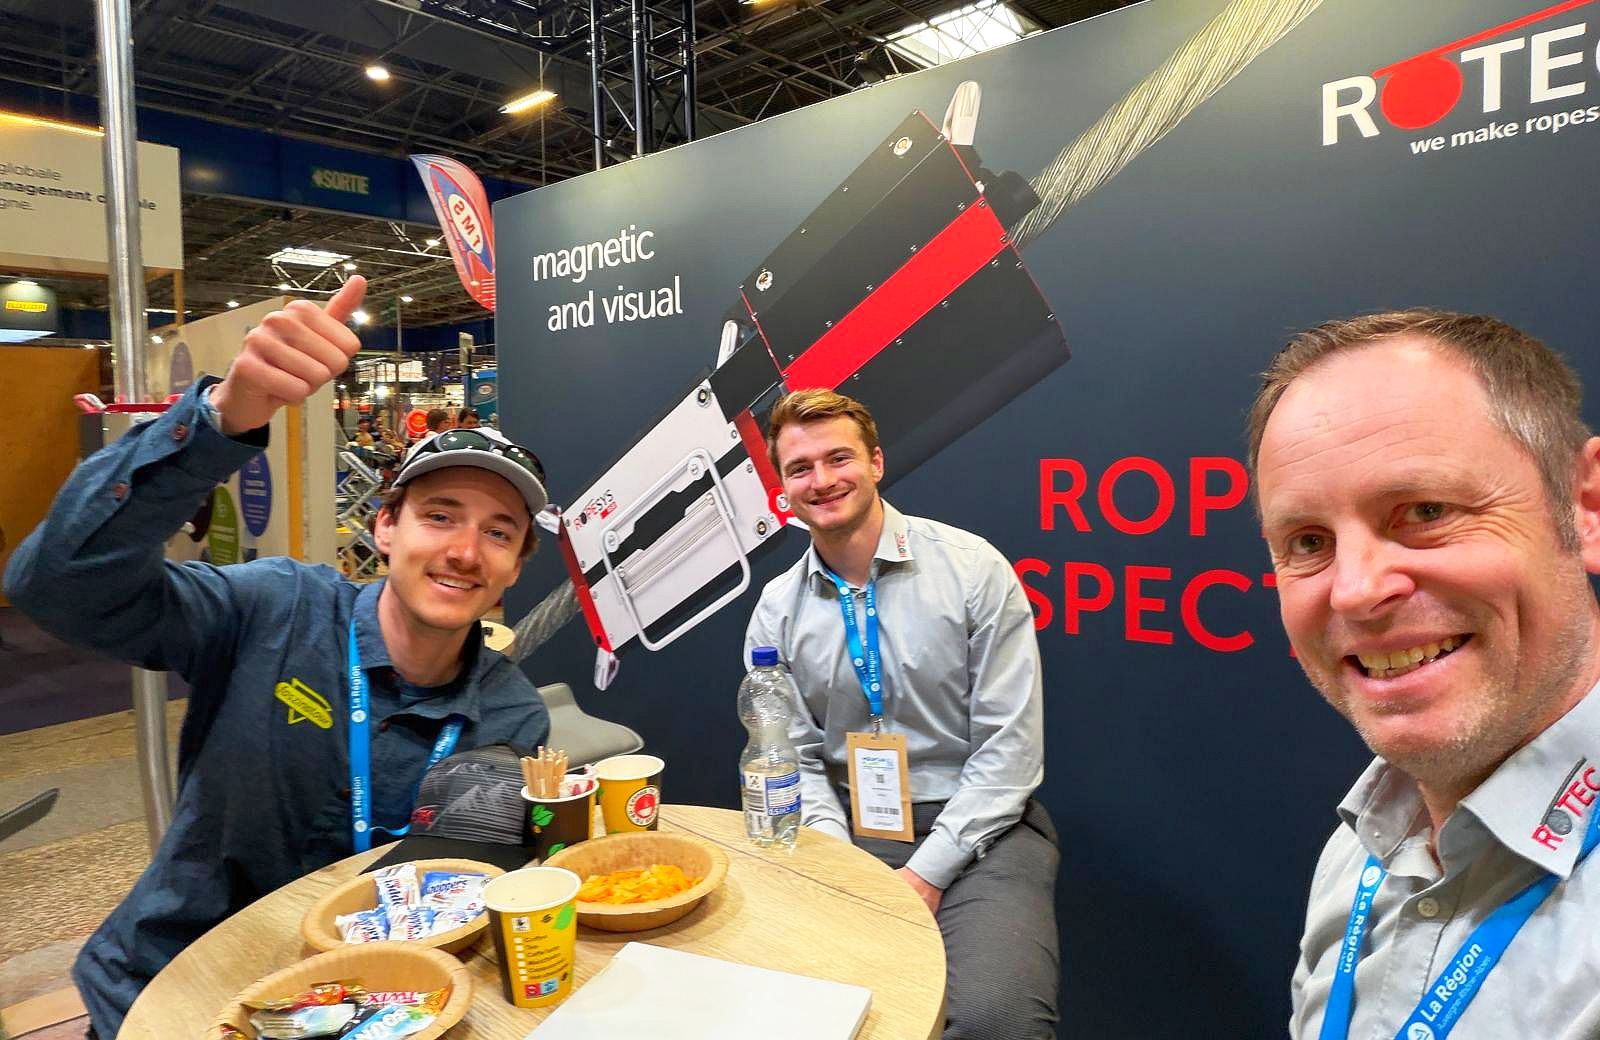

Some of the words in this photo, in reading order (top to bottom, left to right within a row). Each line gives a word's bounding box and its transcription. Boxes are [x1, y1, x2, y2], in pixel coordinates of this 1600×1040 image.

[1322, 22, 1600, 146] ROTE
[1410, 135, 1445, 155] we
[1451, 121, 1519, 148] make
[1525, 104, 1600, 135] ropes
[532, 224, 655, 283] magnetic
[547, 290, 594, 333] and
[602, 275, 683, 324] visual
[1039, 456, 1268, 538] ROP
[1010, 557, 1299, 658] SPEC
[1531, 766, 1600, 851] ROTEC
[1357, 891, 1372, 911] La
[1343, 916, 1365, 973] Région
[1420, 1001, 1441, 1022] La
[1436, 943, 1483, 999] Région
